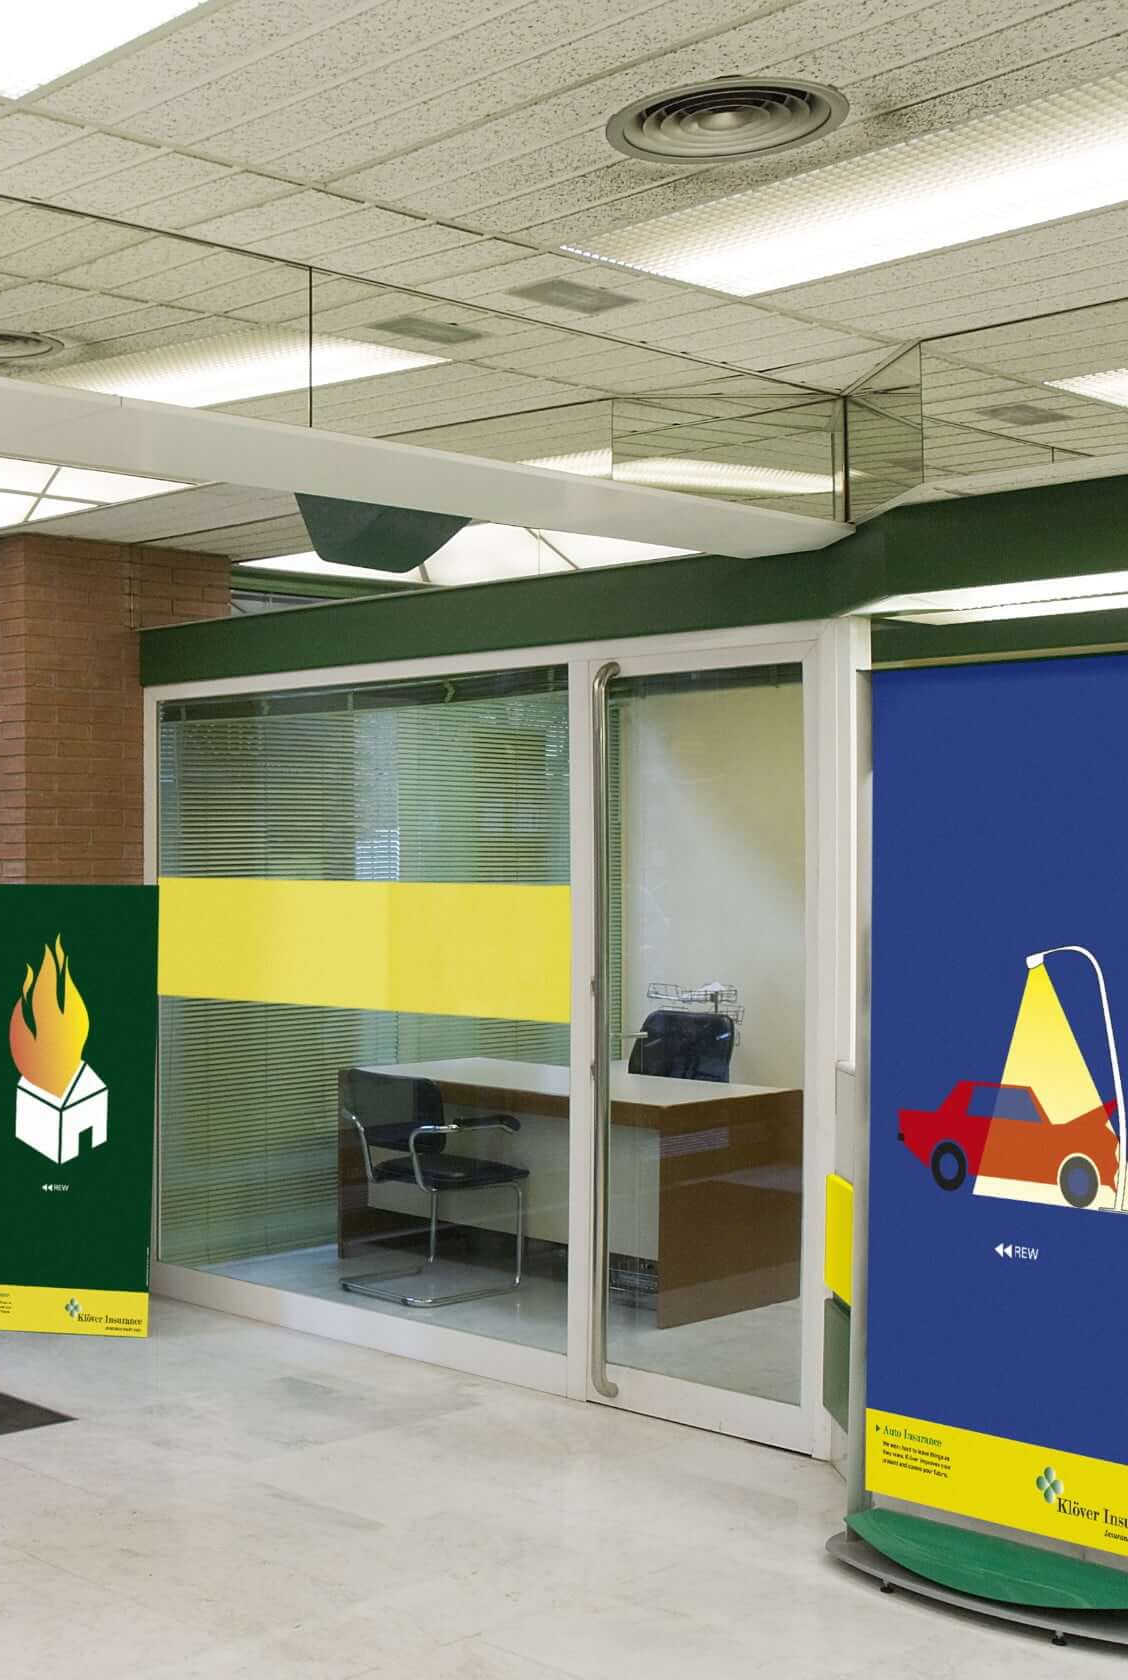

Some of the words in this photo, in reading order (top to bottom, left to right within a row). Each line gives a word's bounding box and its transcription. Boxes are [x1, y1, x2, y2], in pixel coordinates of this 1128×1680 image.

[1014, 1245, 1039, 1260] REW
[78, 1312, 103, 1323] Klöver
[105, 1314, 143, 1326] Insurance
[883, 1425, 902, 1438] Auto
[904, 1428, 942, 1448] Insurance
[1056, 1497, 1100, 1521] Klöver
